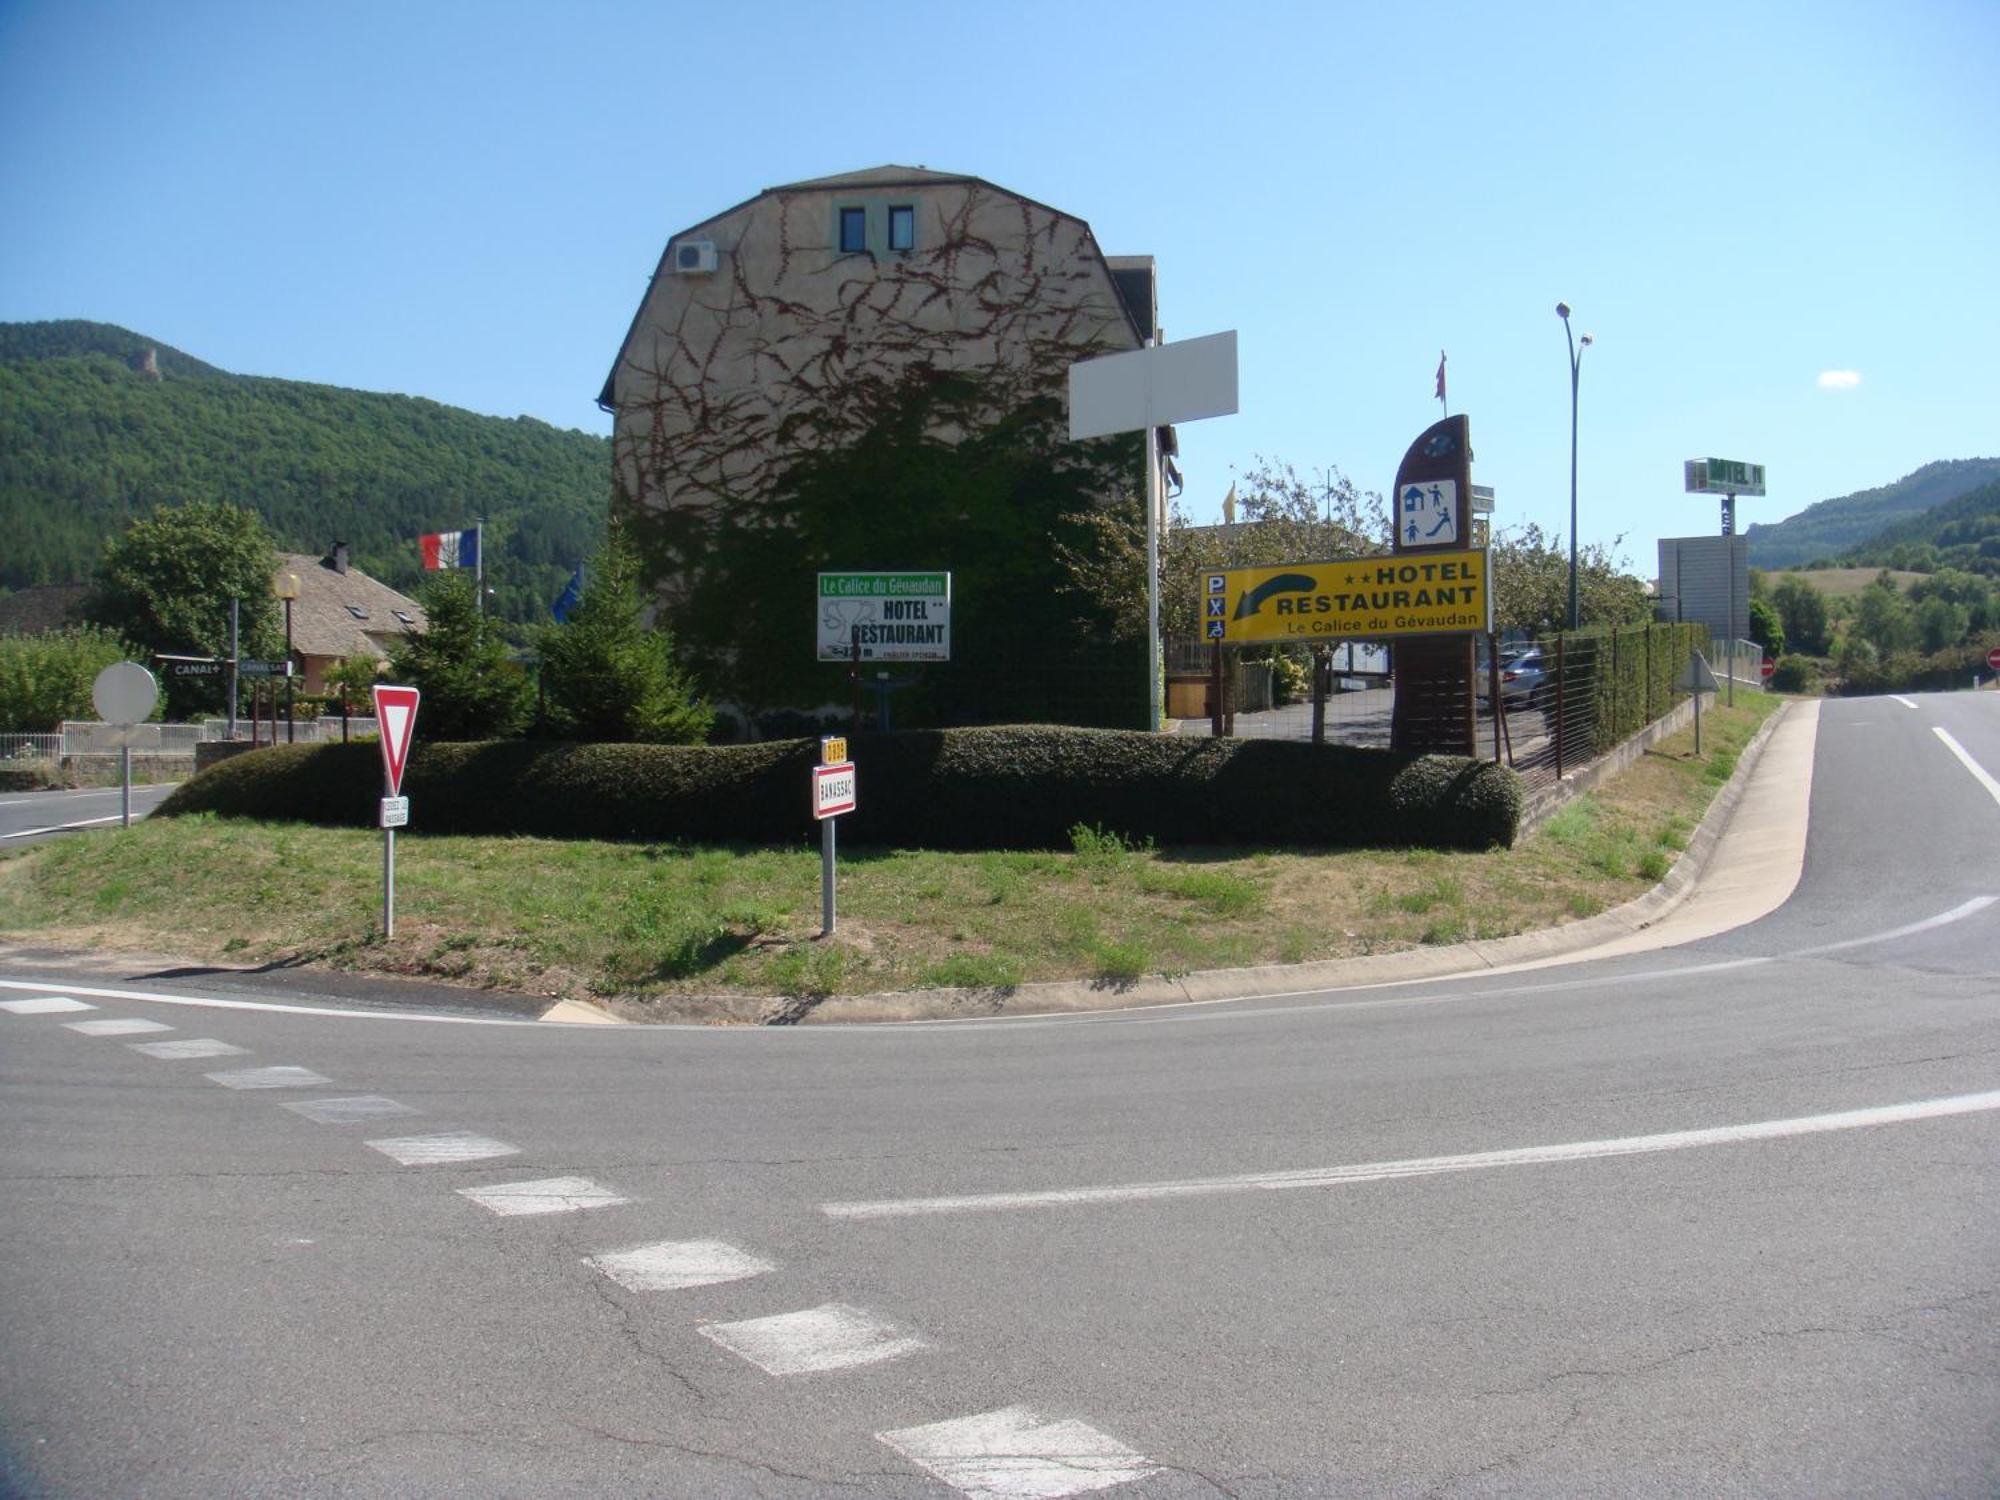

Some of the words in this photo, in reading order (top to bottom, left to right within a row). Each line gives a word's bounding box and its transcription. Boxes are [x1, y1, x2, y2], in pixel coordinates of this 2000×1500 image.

[1376, 562, 1477, 585] HOTEL
[824, 578, 836, 594] Le
[838, 578, 870, 594] Calice
[874, 578, 886, 594] du
[889, 577, 942, 594] Gévaudan
[883, 600, 928, 620] HOTEL
[1277, 587, 1477, 616] RESTAURANT
[1288, 622, 1305, 634] Le
[1312, 619, 1361, 633] Calice
[1368, 617, 1388, 630] du
[1395, 613, 1477, 628] Gévaudan
[175, 664, 221, 675] CANAL+
[821, 779, 852, 801] BANASSAC
